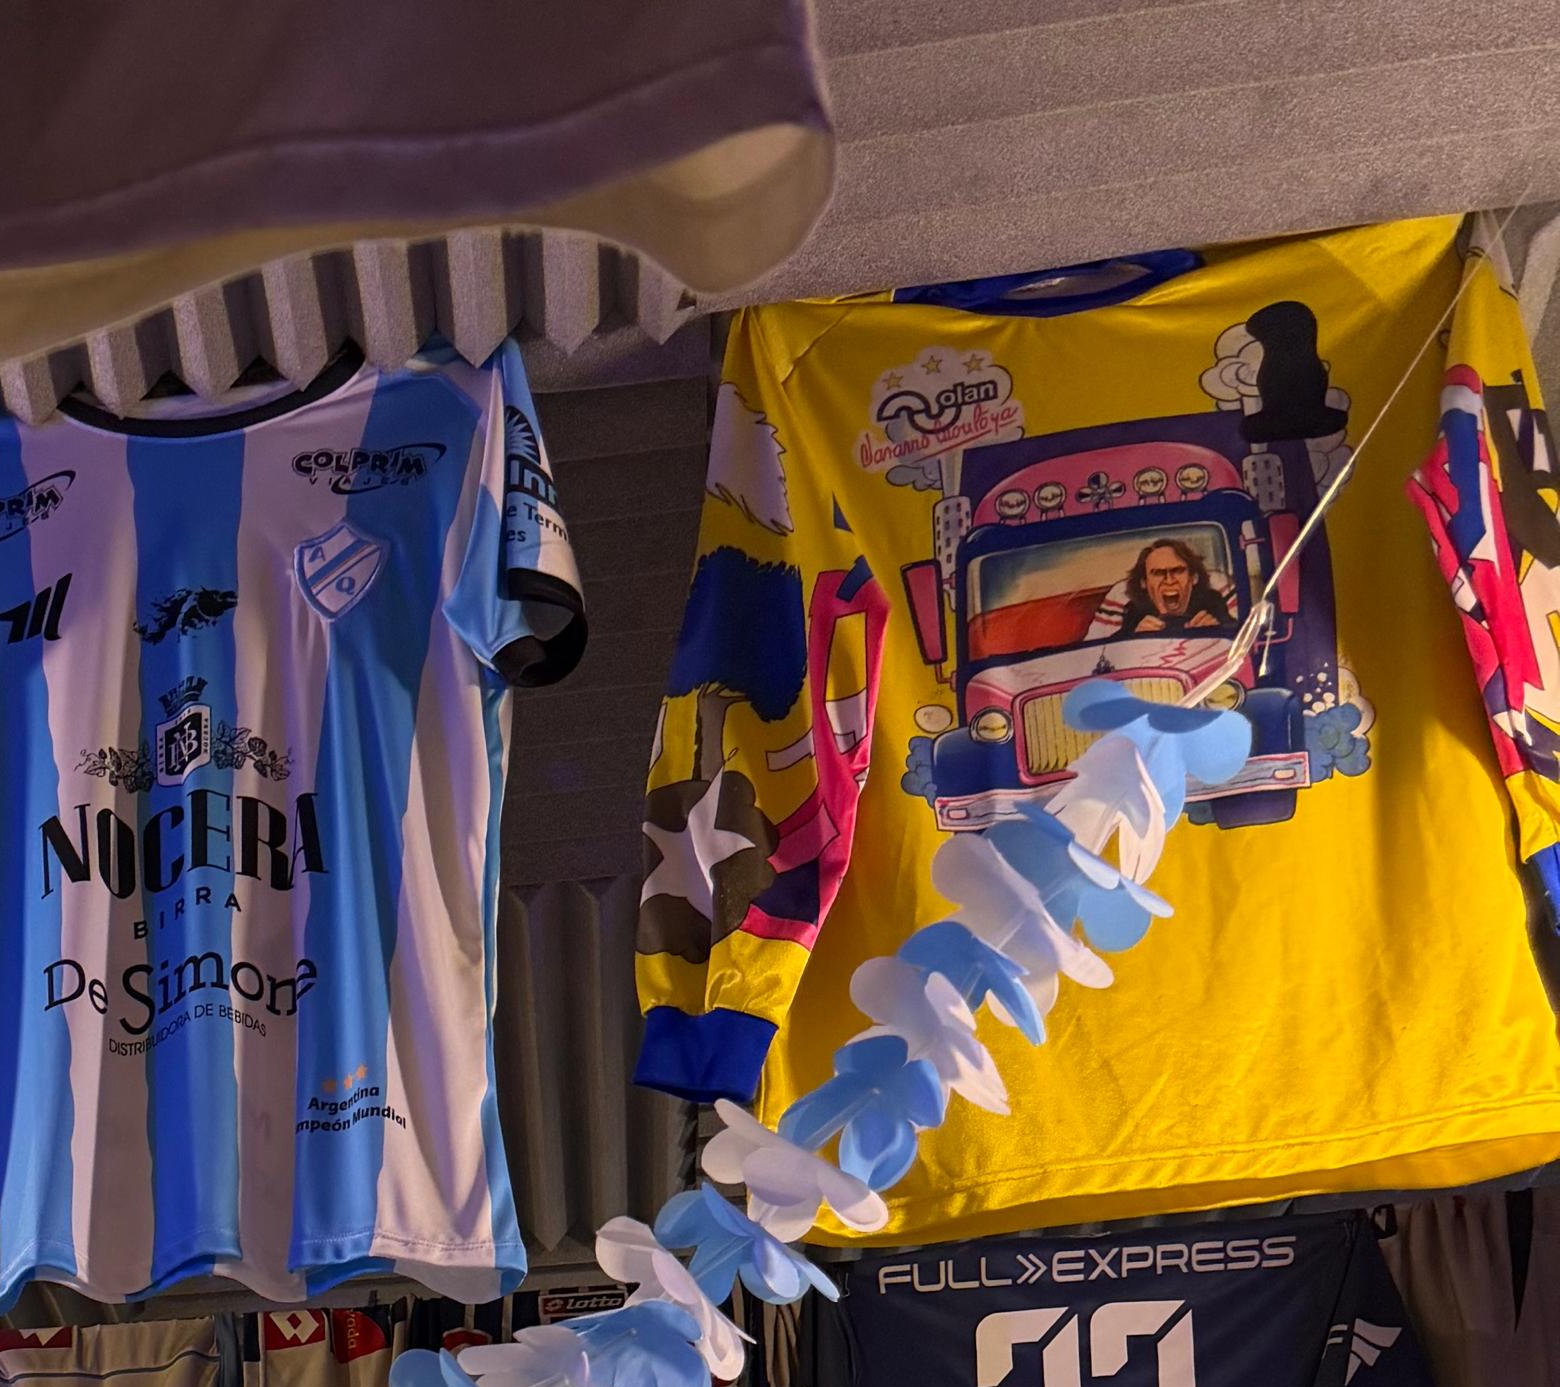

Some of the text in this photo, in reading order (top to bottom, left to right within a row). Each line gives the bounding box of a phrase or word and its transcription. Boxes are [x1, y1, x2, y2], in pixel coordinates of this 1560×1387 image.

[292, 449, 426, 478] COLPRIM
[39, 788, 329, 900] NOCERA
[134, 886, 242, 940] BIRRA
[43, 949, 317, 1036] De Simone
[108, 1003, 267, 1057] DISTRIBUIDORA DE BEBIDAS
[295, 1102, 408, 1134] mpeón Mundial
[307, 1084, 381, 1115] Argentina
[878, 1235, 1296, 1295] FULL EXPRESS
